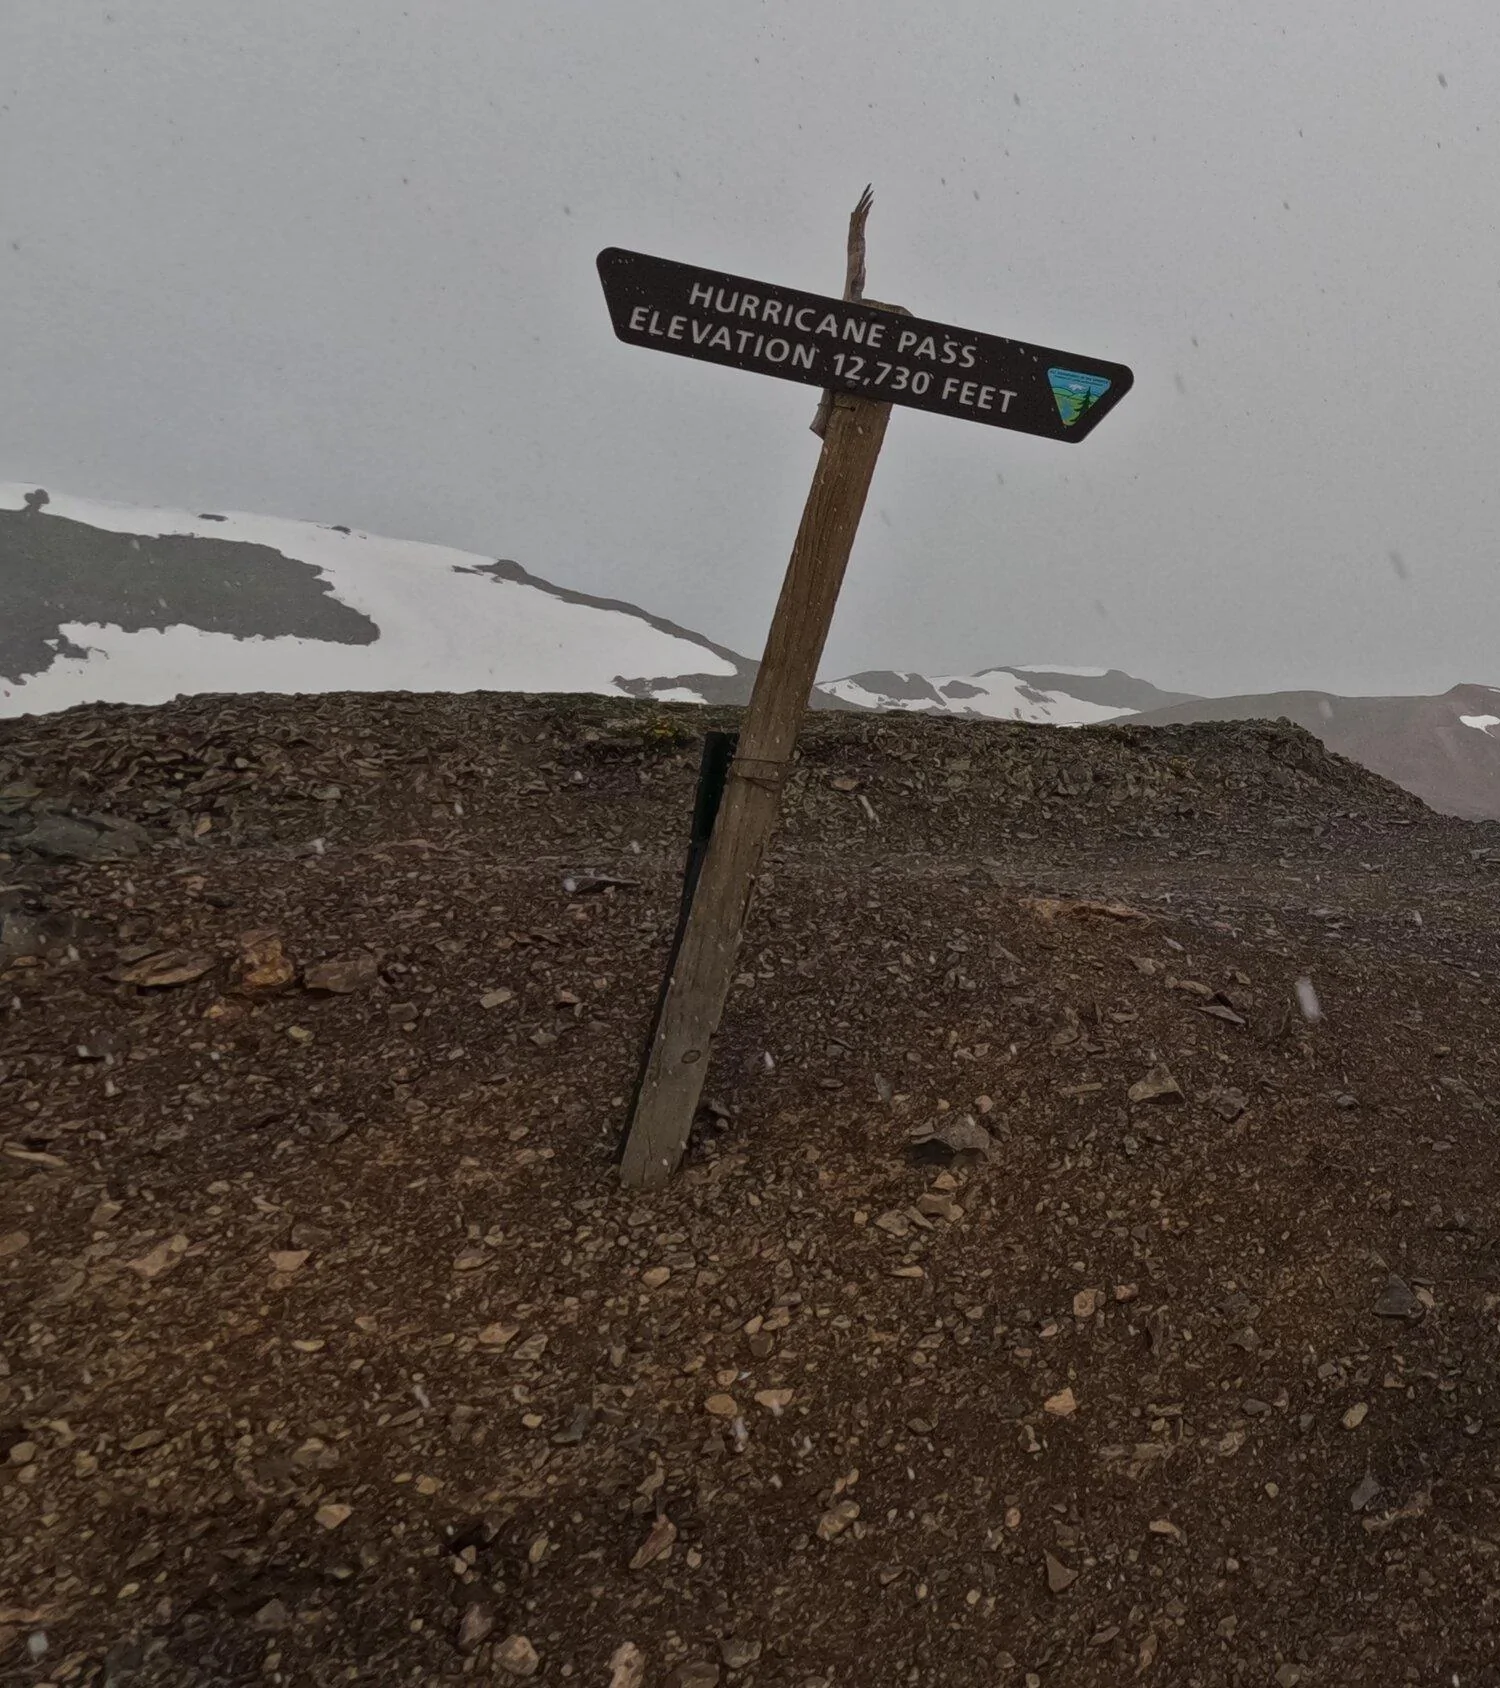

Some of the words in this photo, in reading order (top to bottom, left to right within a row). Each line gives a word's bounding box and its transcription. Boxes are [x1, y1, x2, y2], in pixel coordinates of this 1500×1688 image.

[629, 307, 818, 369] ELEVATION
[833, 353, 931, 395] 12,730
[940, 378, 1017, 413] FEET
[689, 283, 886, 348] HURRICANE
[897, 331, 977, 368] PASS
